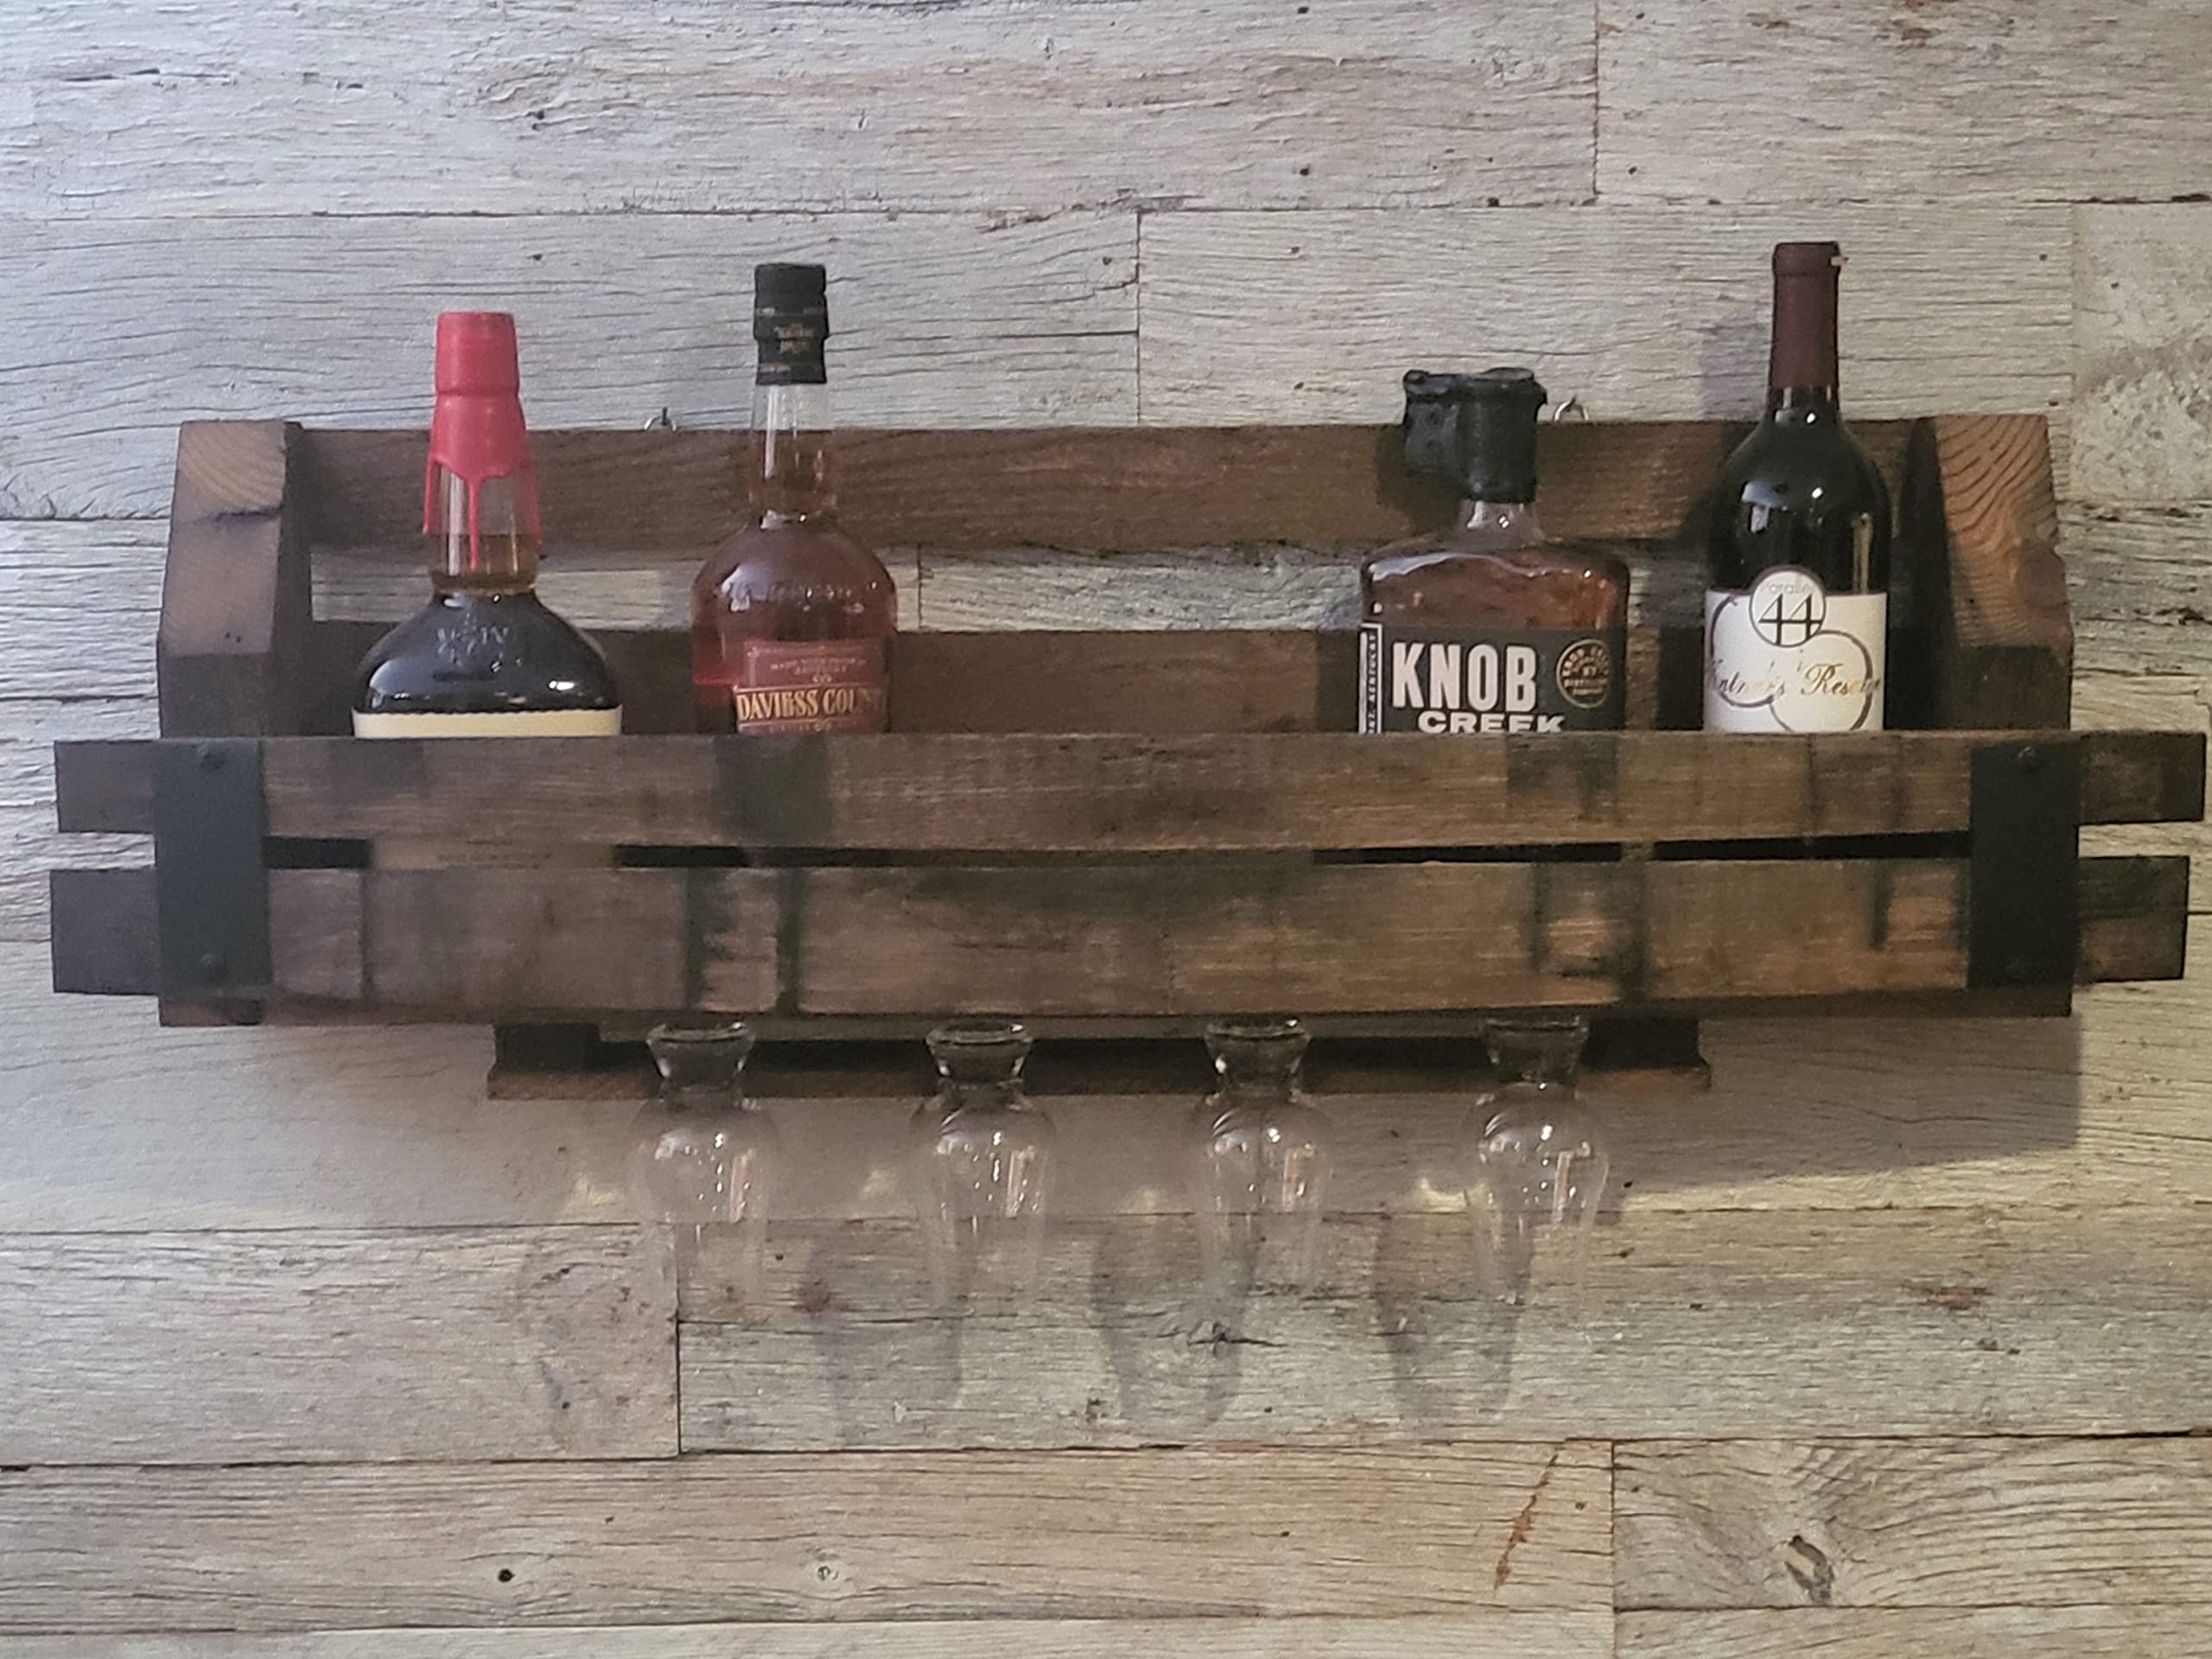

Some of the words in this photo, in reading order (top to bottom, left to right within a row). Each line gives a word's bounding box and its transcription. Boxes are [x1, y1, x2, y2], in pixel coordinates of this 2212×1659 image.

[1758, 593, 1822, 645] 44
[1392, 641, 1537, 712] KNOB
[1800, 663, 1881, 696] Rese
[736, 689, 819, 721] DAVIESS
[823, 687, 887, 718] COU
[1417, 709, 1567, 734] CREEK
